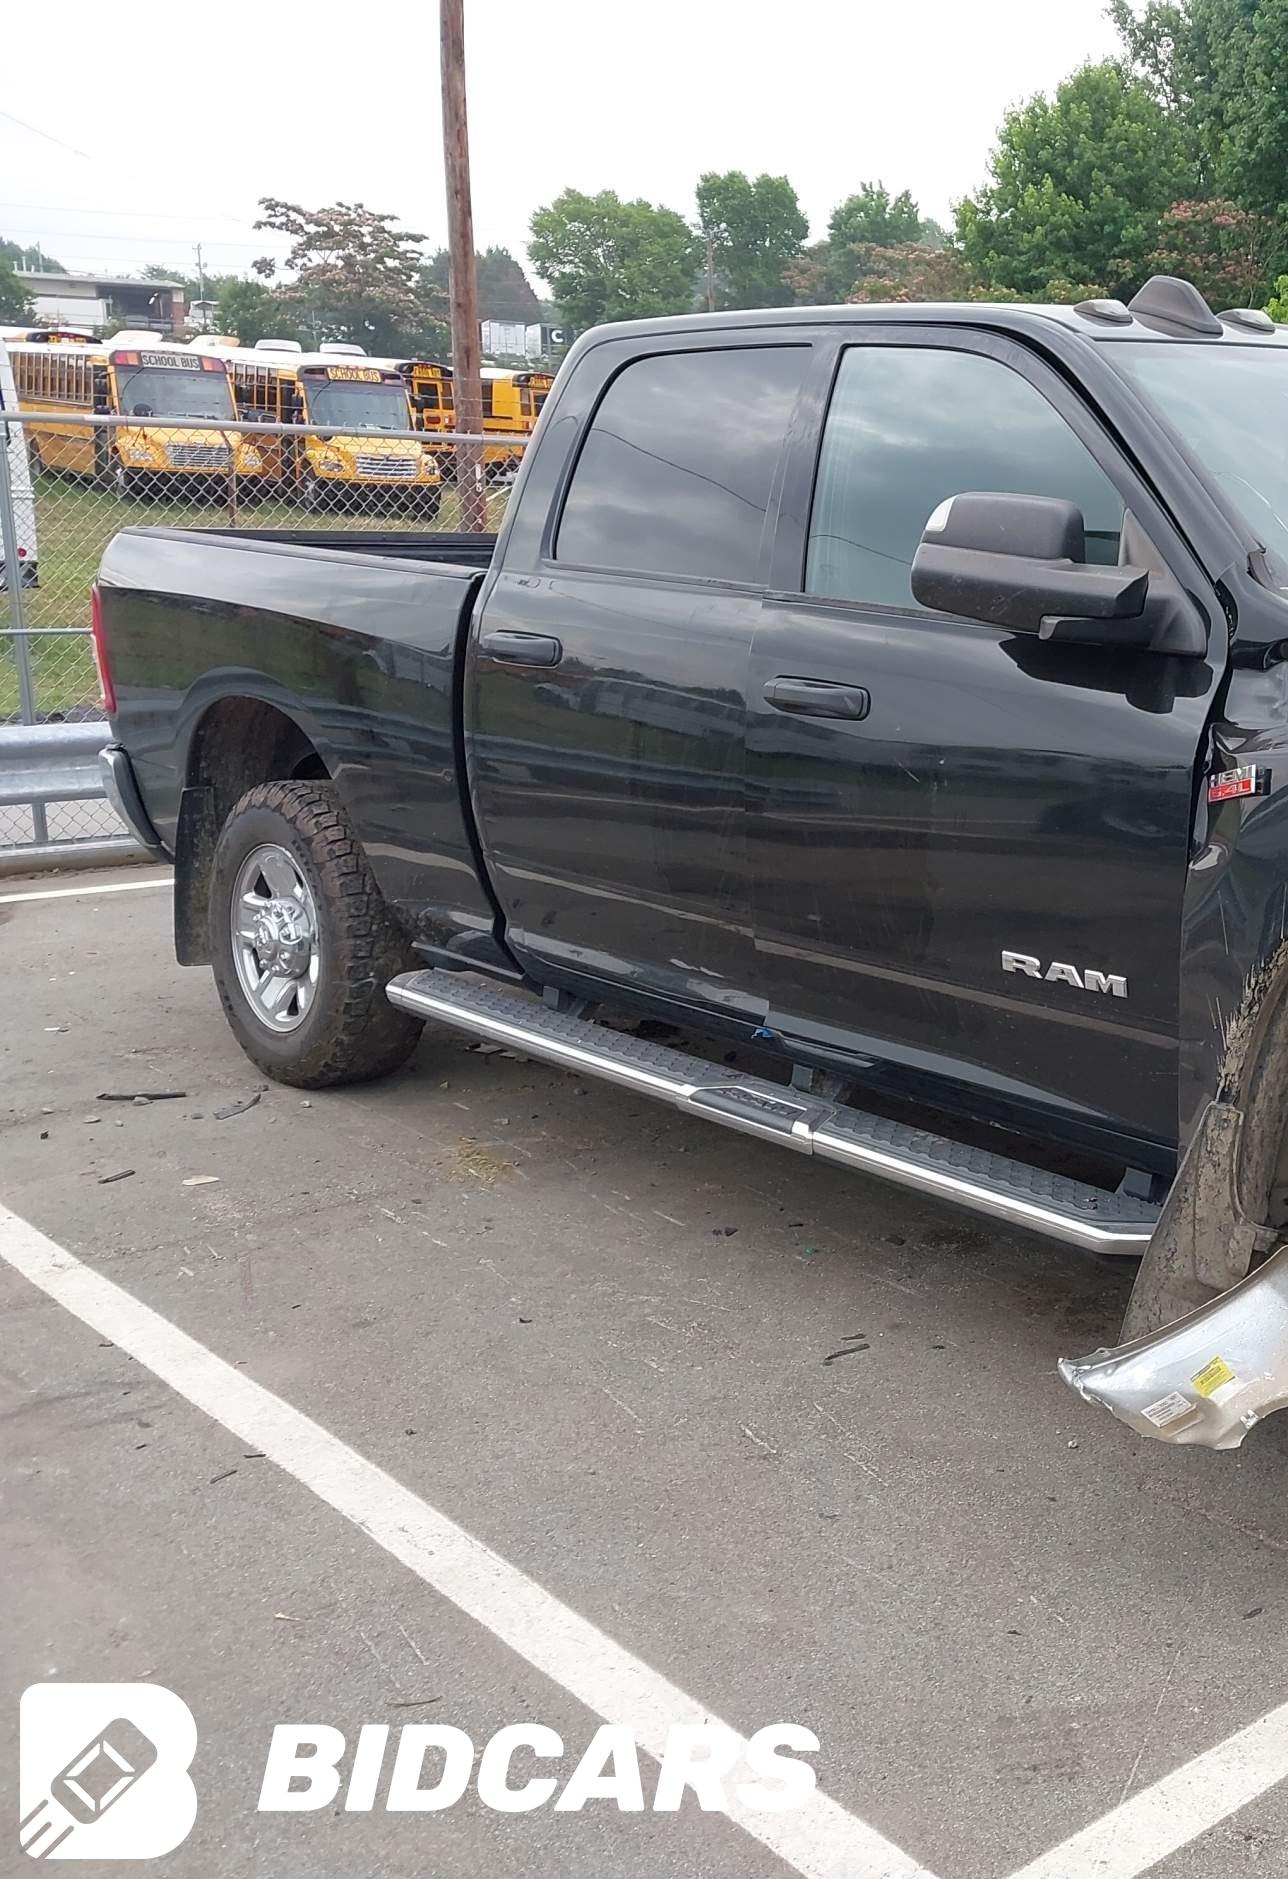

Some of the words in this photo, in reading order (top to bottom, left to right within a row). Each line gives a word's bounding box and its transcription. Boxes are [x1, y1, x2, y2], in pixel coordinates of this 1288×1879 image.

[142, 354, 180, 367] SCHOOL
[180, 357, 199, 369] BUS
[329, 367, 363, 380] SCHOOL
[364, 370, 379, 382] BUS
[1210, 764, 1256, 788] HEMI
[1002, 950, 1128, 998] RAM
